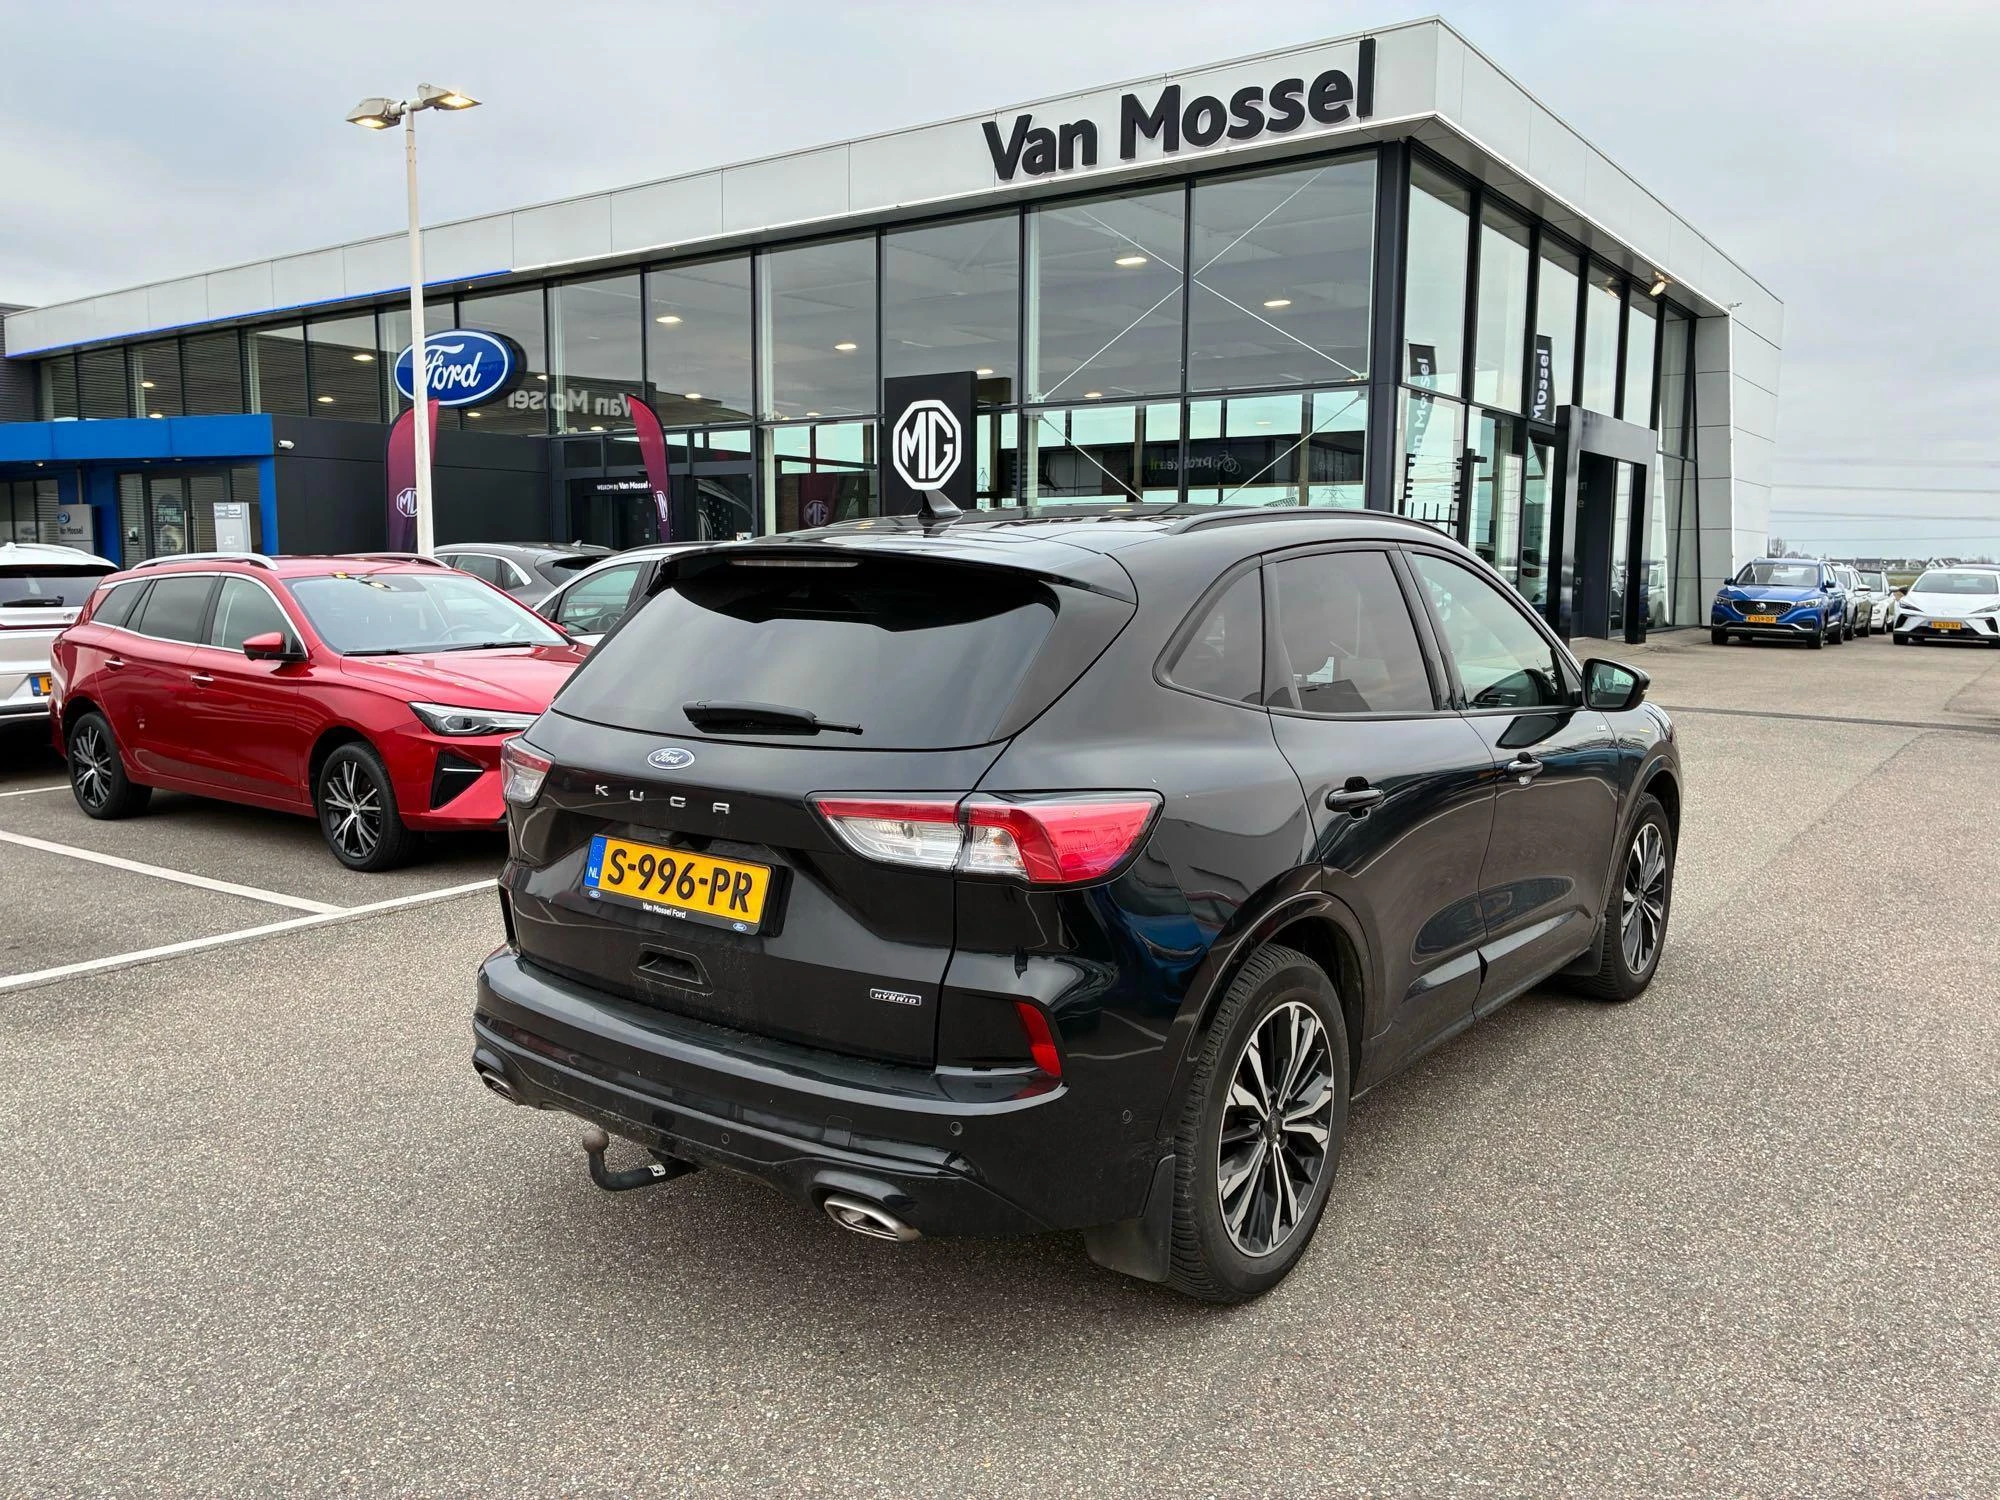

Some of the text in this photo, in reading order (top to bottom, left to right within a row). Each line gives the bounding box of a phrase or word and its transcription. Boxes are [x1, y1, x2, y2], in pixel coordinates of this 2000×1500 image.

[981, 37, 1377, 181] Van Mossel
[424, 343, 483, 391] Ford
[901, 410, 954, 479] MG
[619, 481, 629, 490] Van
[629, 480, 648, 490] Mossel
[654, 750, 685, 765] Ford
[594, 784, 731, 815] KUGA
[588, 847, 753, 914] NL S-996-PR
[642, 902, 687, 919] Van Mossel Ford
[874, 992, 918, 1005] HYBRID
